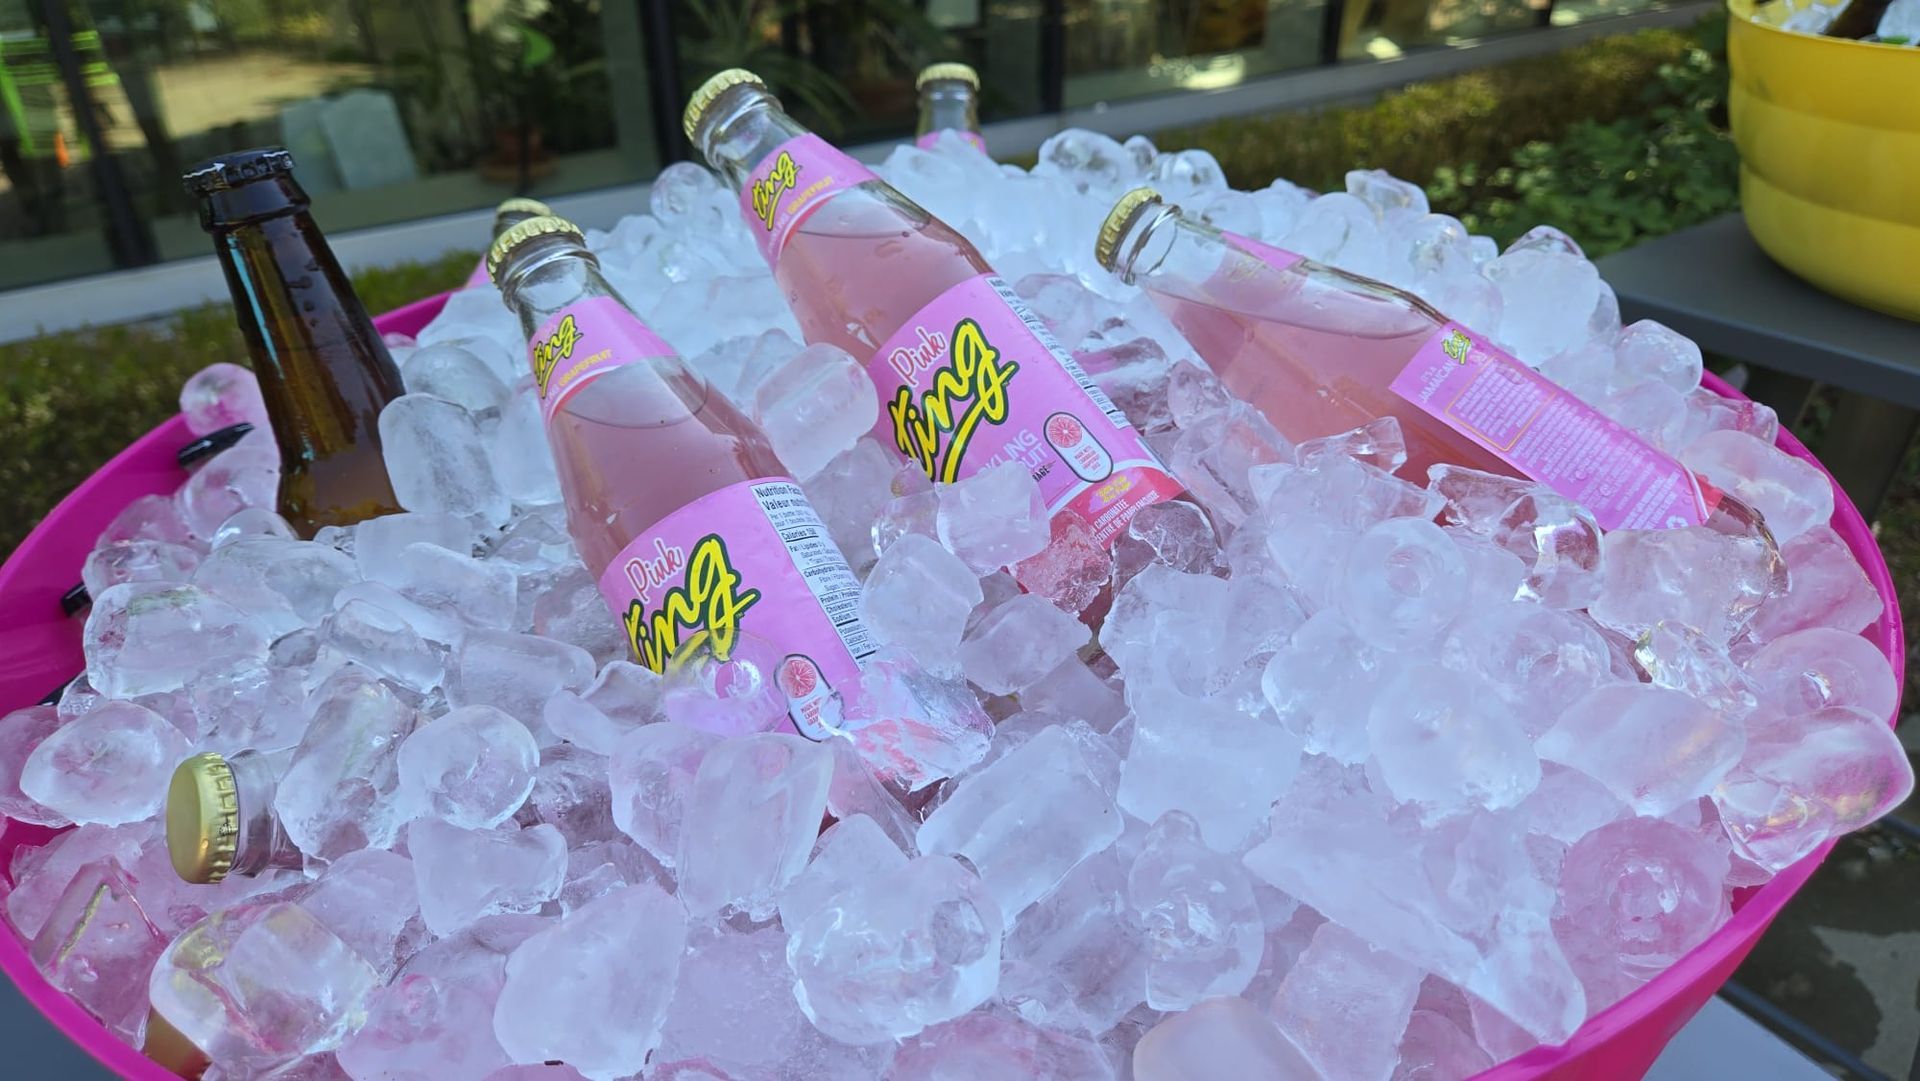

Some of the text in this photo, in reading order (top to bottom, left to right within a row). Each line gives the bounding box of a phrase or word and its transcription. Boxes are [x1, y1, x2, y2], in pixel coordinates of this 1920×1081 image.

[888, 326, 948, 387] Pink
[1419, 359, 1455, 403] JAMAICAN
[755, 485, 788, 497] Nutrition
[762, 499, 790, 510] Valeur
[1112, 516, 1125, 529] DE
[781, 530, 807, 540] Calories
[625, 537, 685, 604] Pink
